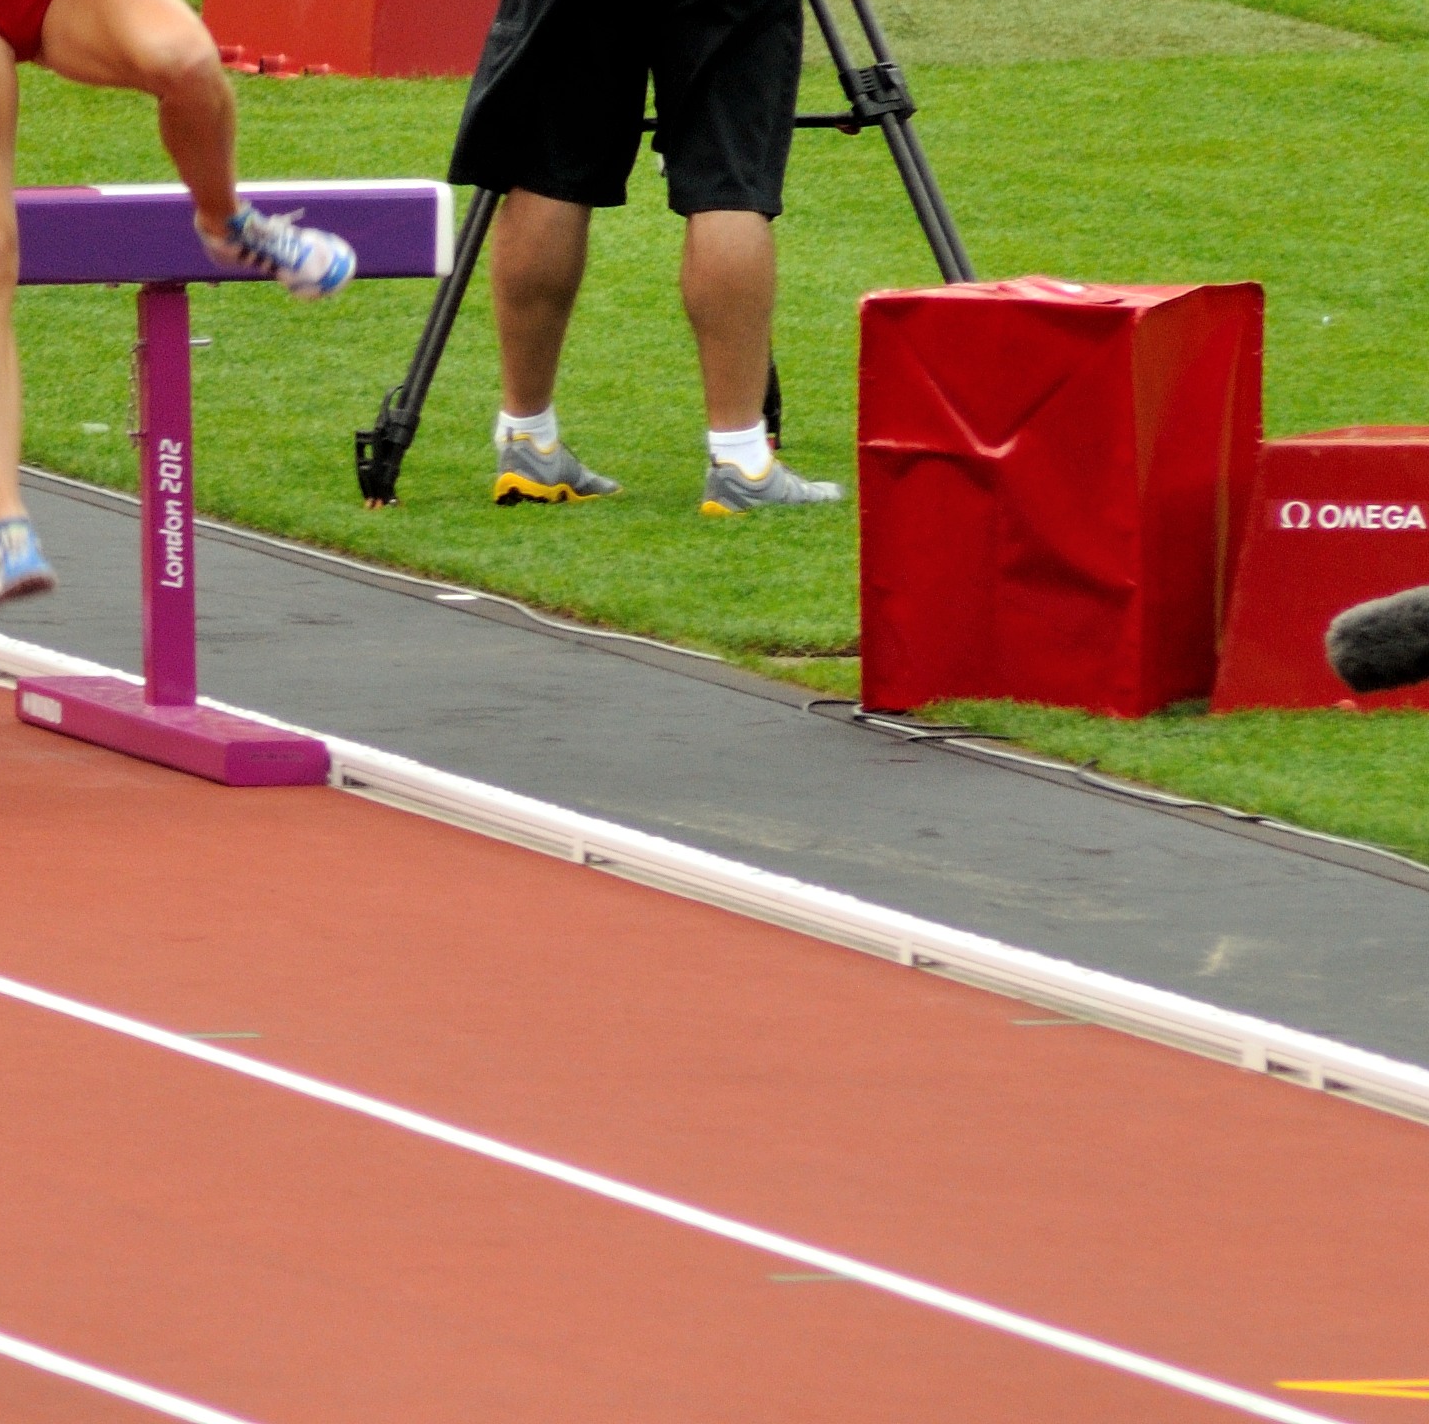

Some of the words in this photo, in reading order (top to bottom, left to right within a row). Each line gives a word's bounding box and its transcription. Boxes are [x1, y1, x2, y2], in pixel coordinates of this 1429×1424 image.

[157, 438, 183, 494] 2012
[159, 501, 184, 589] London
[1316, 504, 1428, 530] OMEGA
